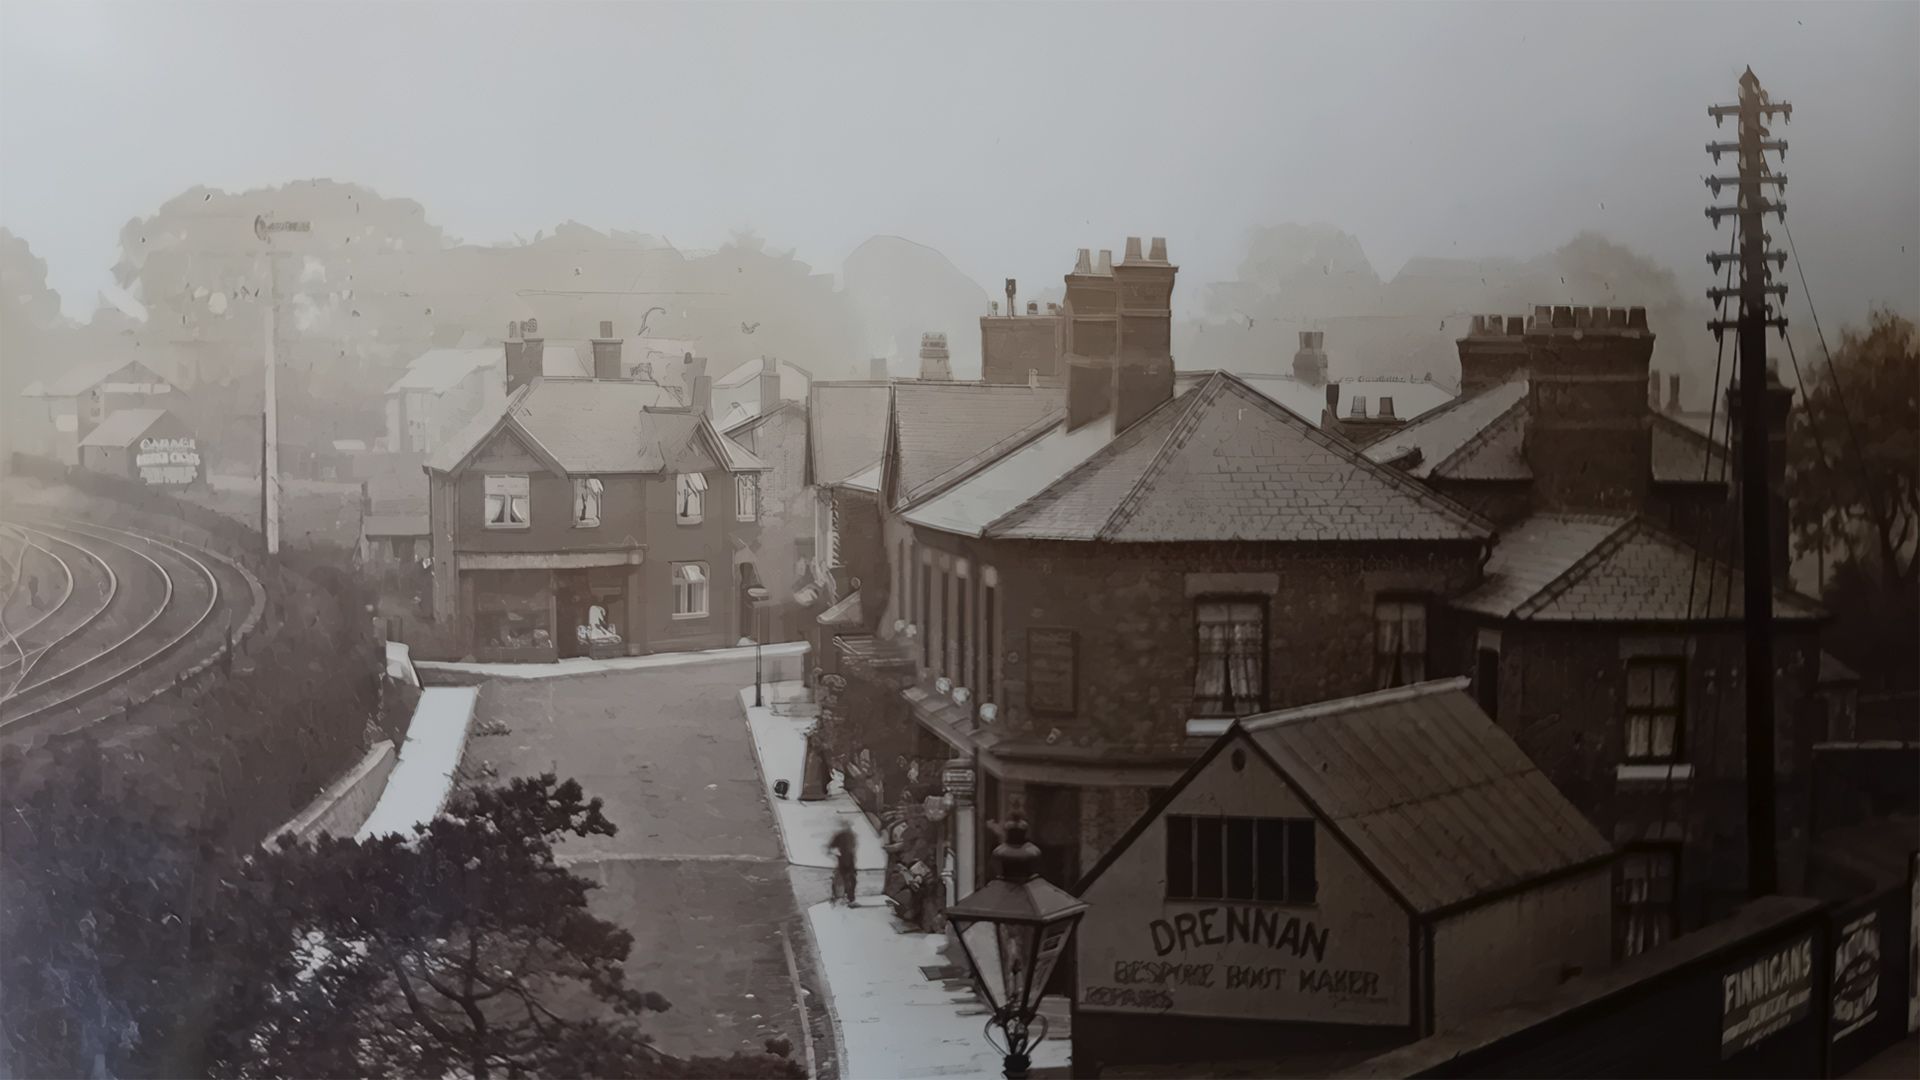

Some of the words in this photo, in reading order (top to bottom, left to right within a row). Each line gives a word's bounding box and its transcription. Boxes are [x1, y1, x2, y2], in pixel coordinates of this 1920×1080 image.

[1149, 906, 1330, 963] DRENNAN
[1225, 965, 1287, 991] BOOT
[1299, 968, 1379, 996] MAKER
